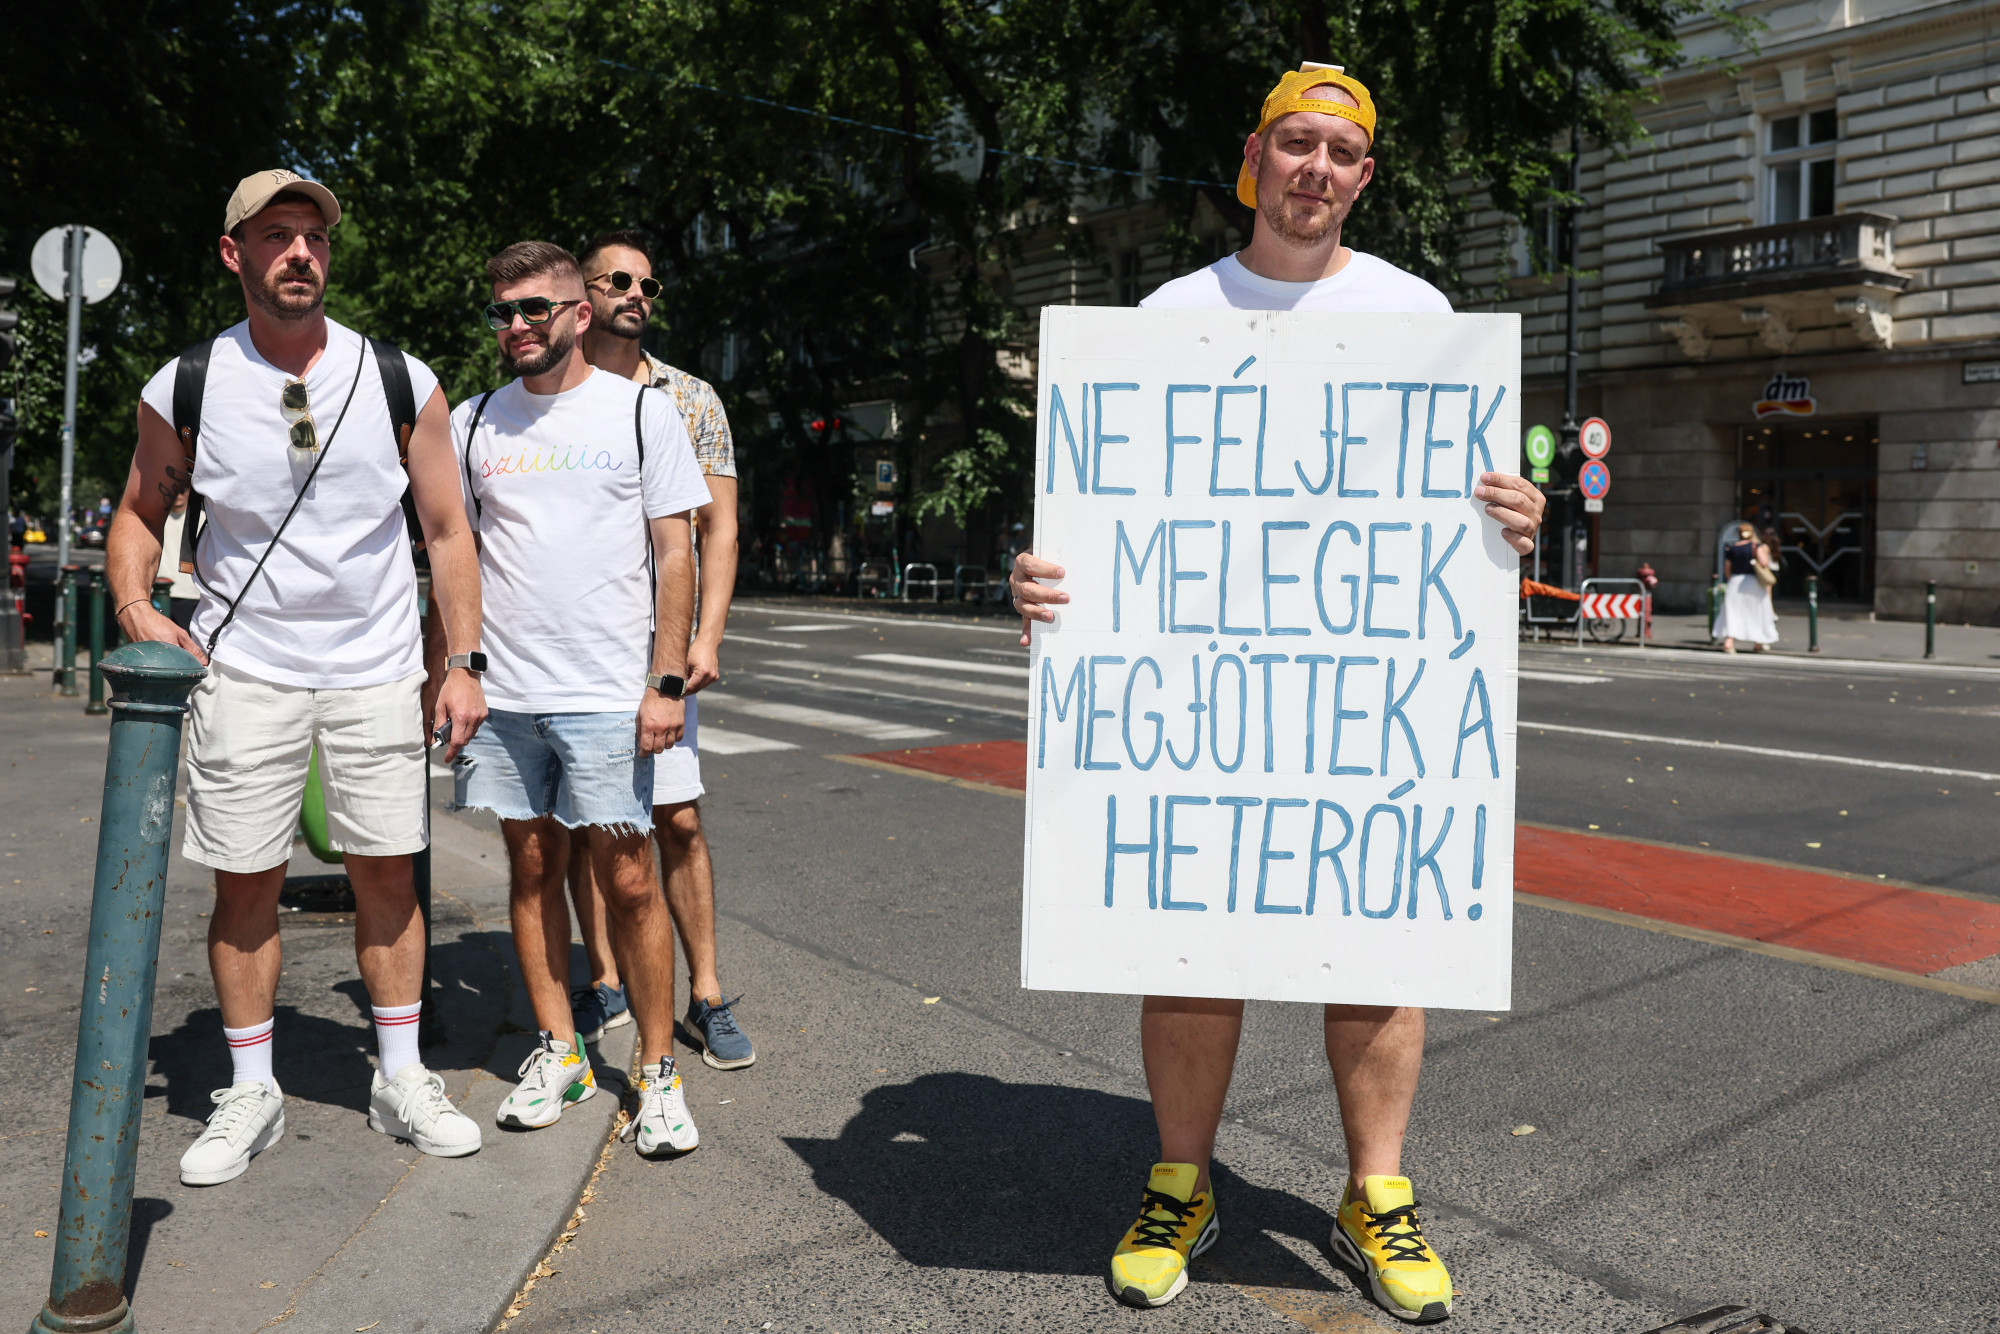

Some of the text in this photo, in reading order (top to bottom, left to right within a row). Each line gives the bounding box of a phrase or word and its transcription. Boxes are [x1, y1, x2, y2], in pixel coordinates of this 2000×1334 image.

[1046, 355, 1507, 499] NE FÉLJETEK
[1589, 433, 1602, 446] 40
[1766, 374, 1807, 400] dm
[1112, 519, 1477, 660] MELEGEK,
[1038, 641, 1427, 779] MEGJÖTTEK
[1104, 780, 1487, 921] HETERÓK!
